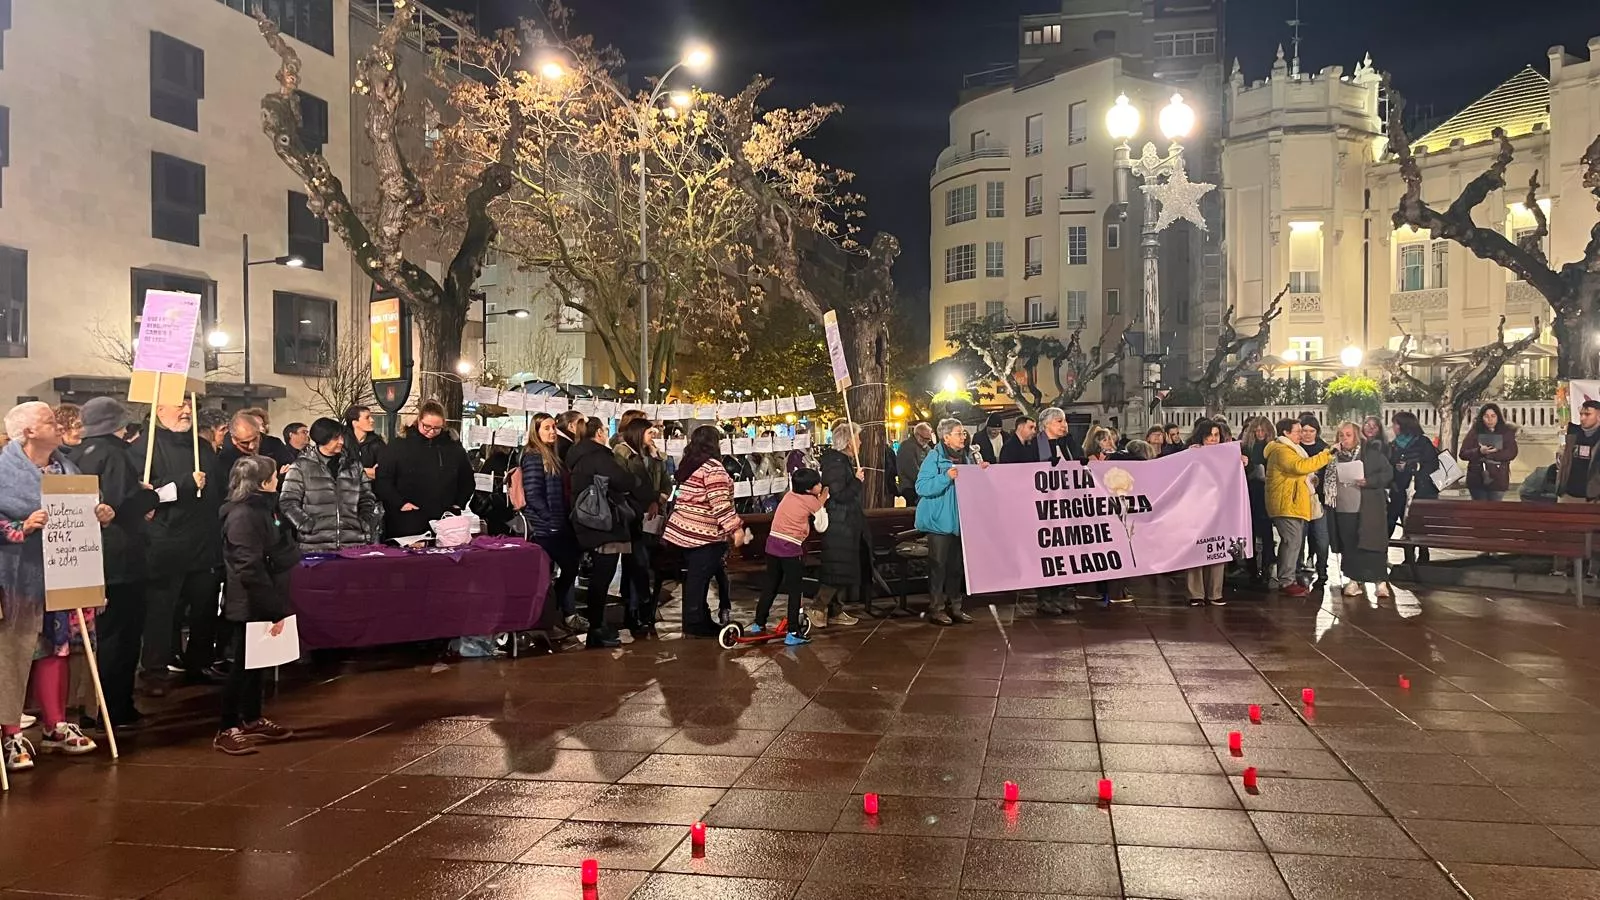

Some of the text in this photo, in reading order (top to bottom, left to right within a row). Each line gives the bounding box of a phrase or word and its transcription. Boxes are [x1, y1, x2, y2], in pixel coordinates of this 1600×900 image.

[1034, 469, 1095, 493] QUE LA
[47, 502, 83, 517] Violencia
[1035, 494, 1153, 520] VERGÜENZA
[1037, 523, 1113, 549] CAMBIE
[1196, 536, 1225, 545] ASAMBLEA
[1206, 552, 1226, 560] HUESCA
[1207, 541, 1225, 553] 8 M
[1040, 550, 1122, 577] DE LADO
